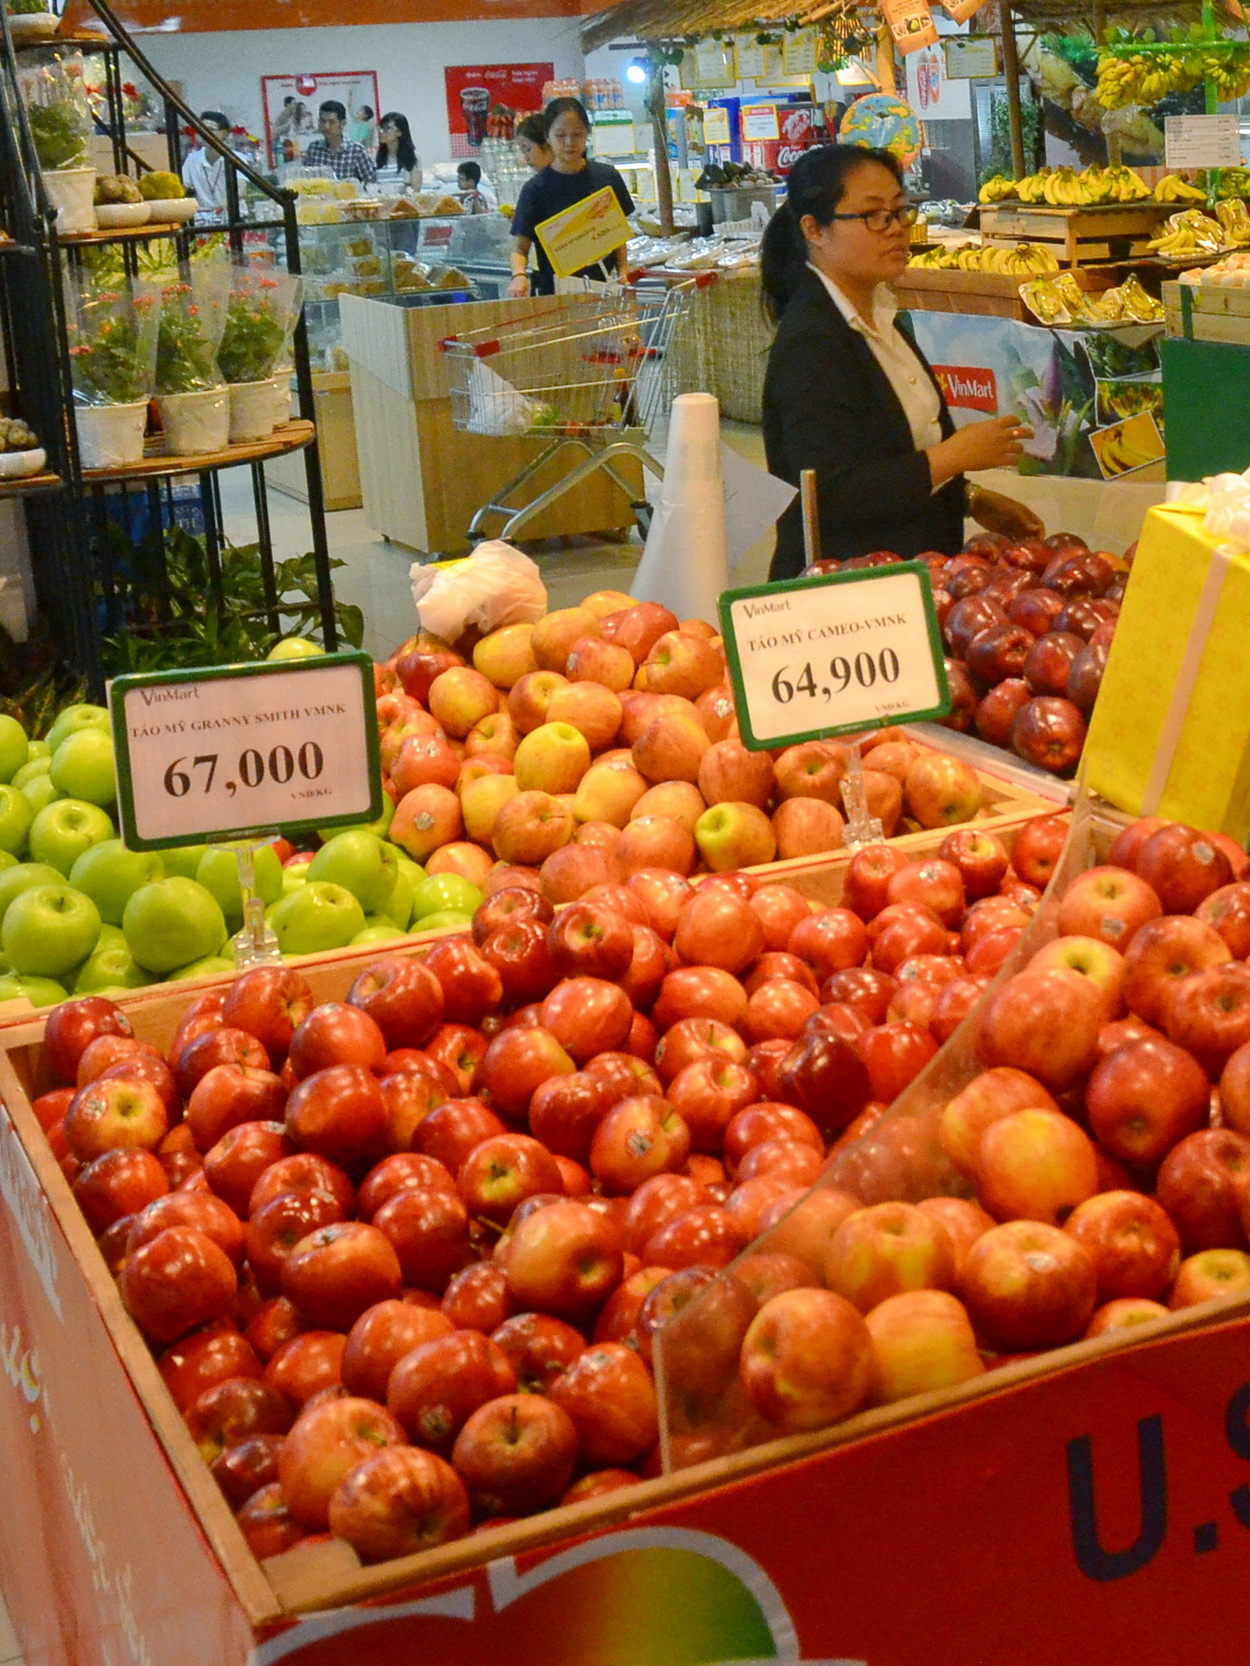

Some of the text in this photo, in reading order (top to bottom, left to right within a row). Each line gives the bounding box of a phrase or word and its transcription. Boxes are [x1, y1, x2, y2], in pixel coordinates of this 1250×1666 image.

[946, 373, 994, 399] VinMart
[742, 599, 792, 619] VinMart
[771, 647, 901, 705] 64,900
[139, 686, 201, 707] VinMart
[130, 723, 161, 739] TÁO
[190, 714, 251, 732] GRANNY
[254, 708, 301, 725] SMITH
[304, 703, 347, 718] VMNK
[163, 741, 324, 798] 67,000
